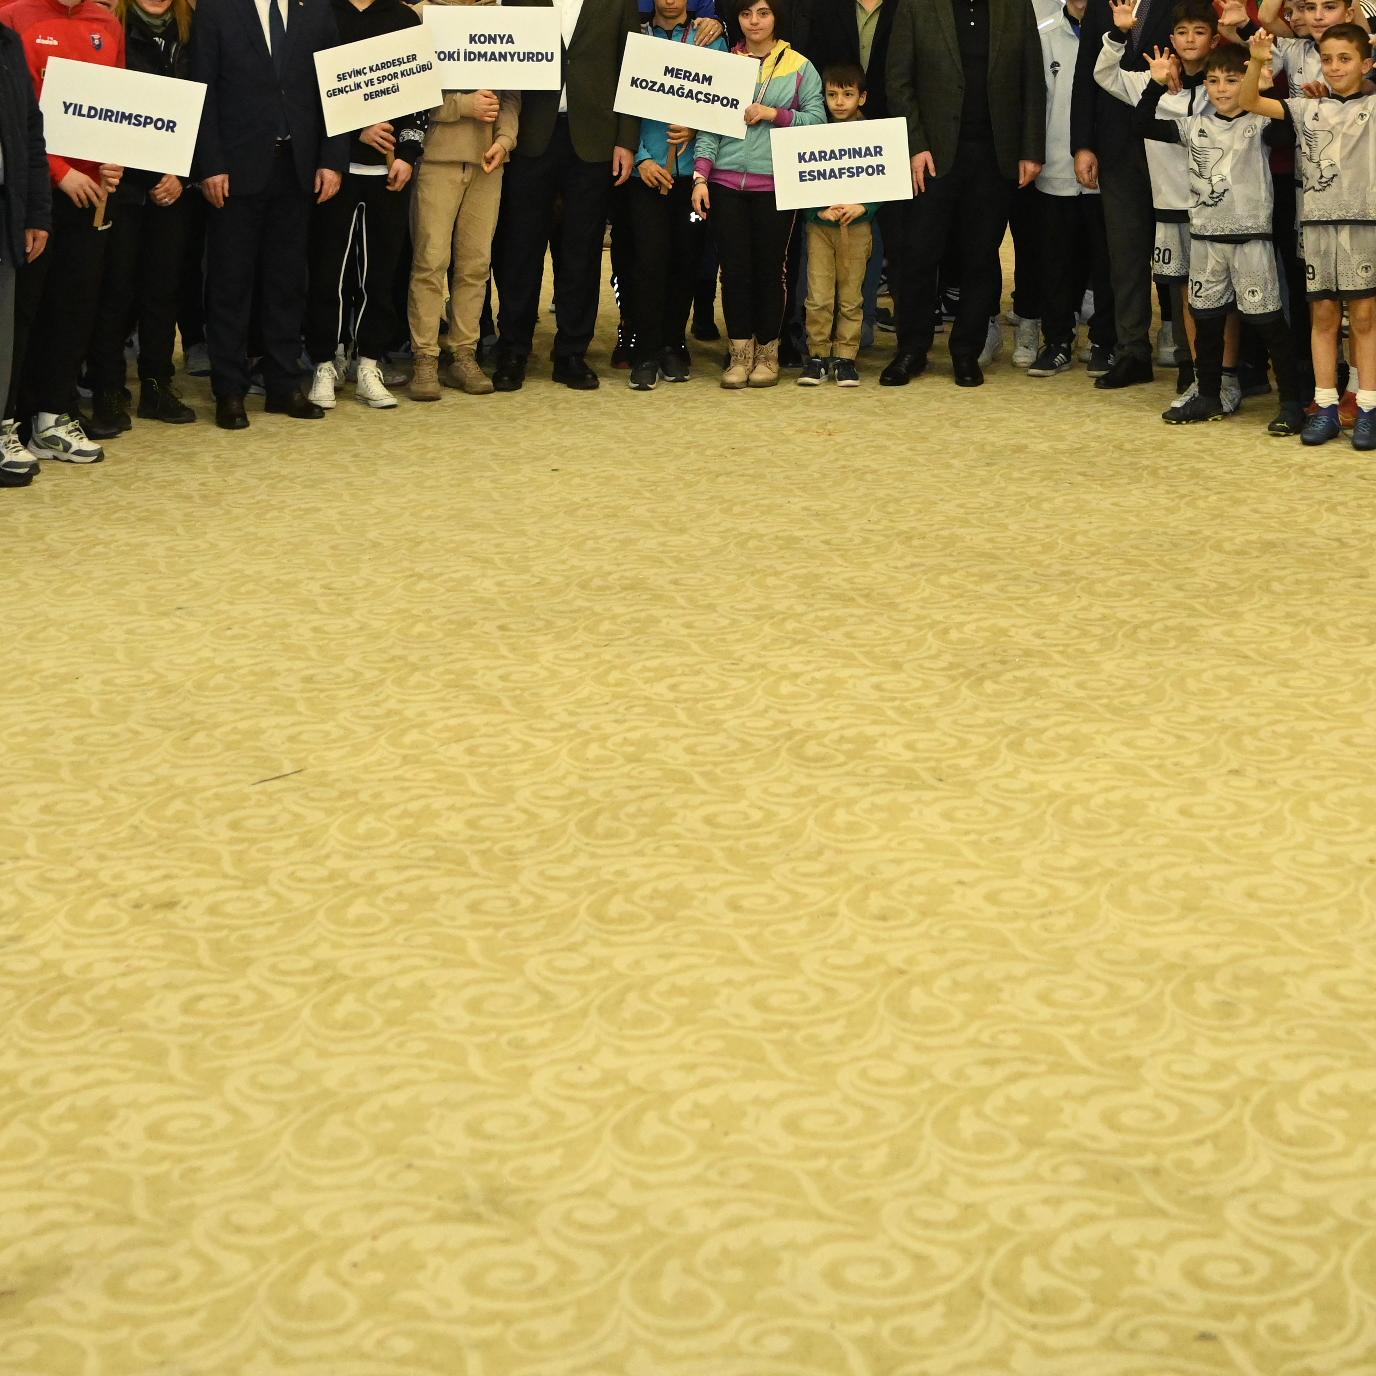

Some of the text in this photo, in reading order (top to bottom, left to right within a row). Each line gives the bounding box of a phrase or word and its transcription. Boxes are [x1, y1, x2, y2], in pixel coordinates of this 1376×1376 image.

[468, 33, 515, 45] KONYA
[434, 48, 554, 63] OKİ İDMANYURDU
[336, 53, 417, 82] SEVİNÇ KARDEŞLER
[663, 65, 713, 86] MERAM
[326, 60, 433, 98] GENÇLİK VE SPOR KULÜBÜ
[363, 82, 400, 102] DERNEĞİ
[630, 76, 740, 110] KOZAAĞAÇSPOR
[62, 101, 177, 133] YILDIRIMSPOR
[797, 145, 883, 164] KARAPINAR
[798, 164, 886, 183] ESNAFSPOR
[1154, 247, 1172, 264] 30
